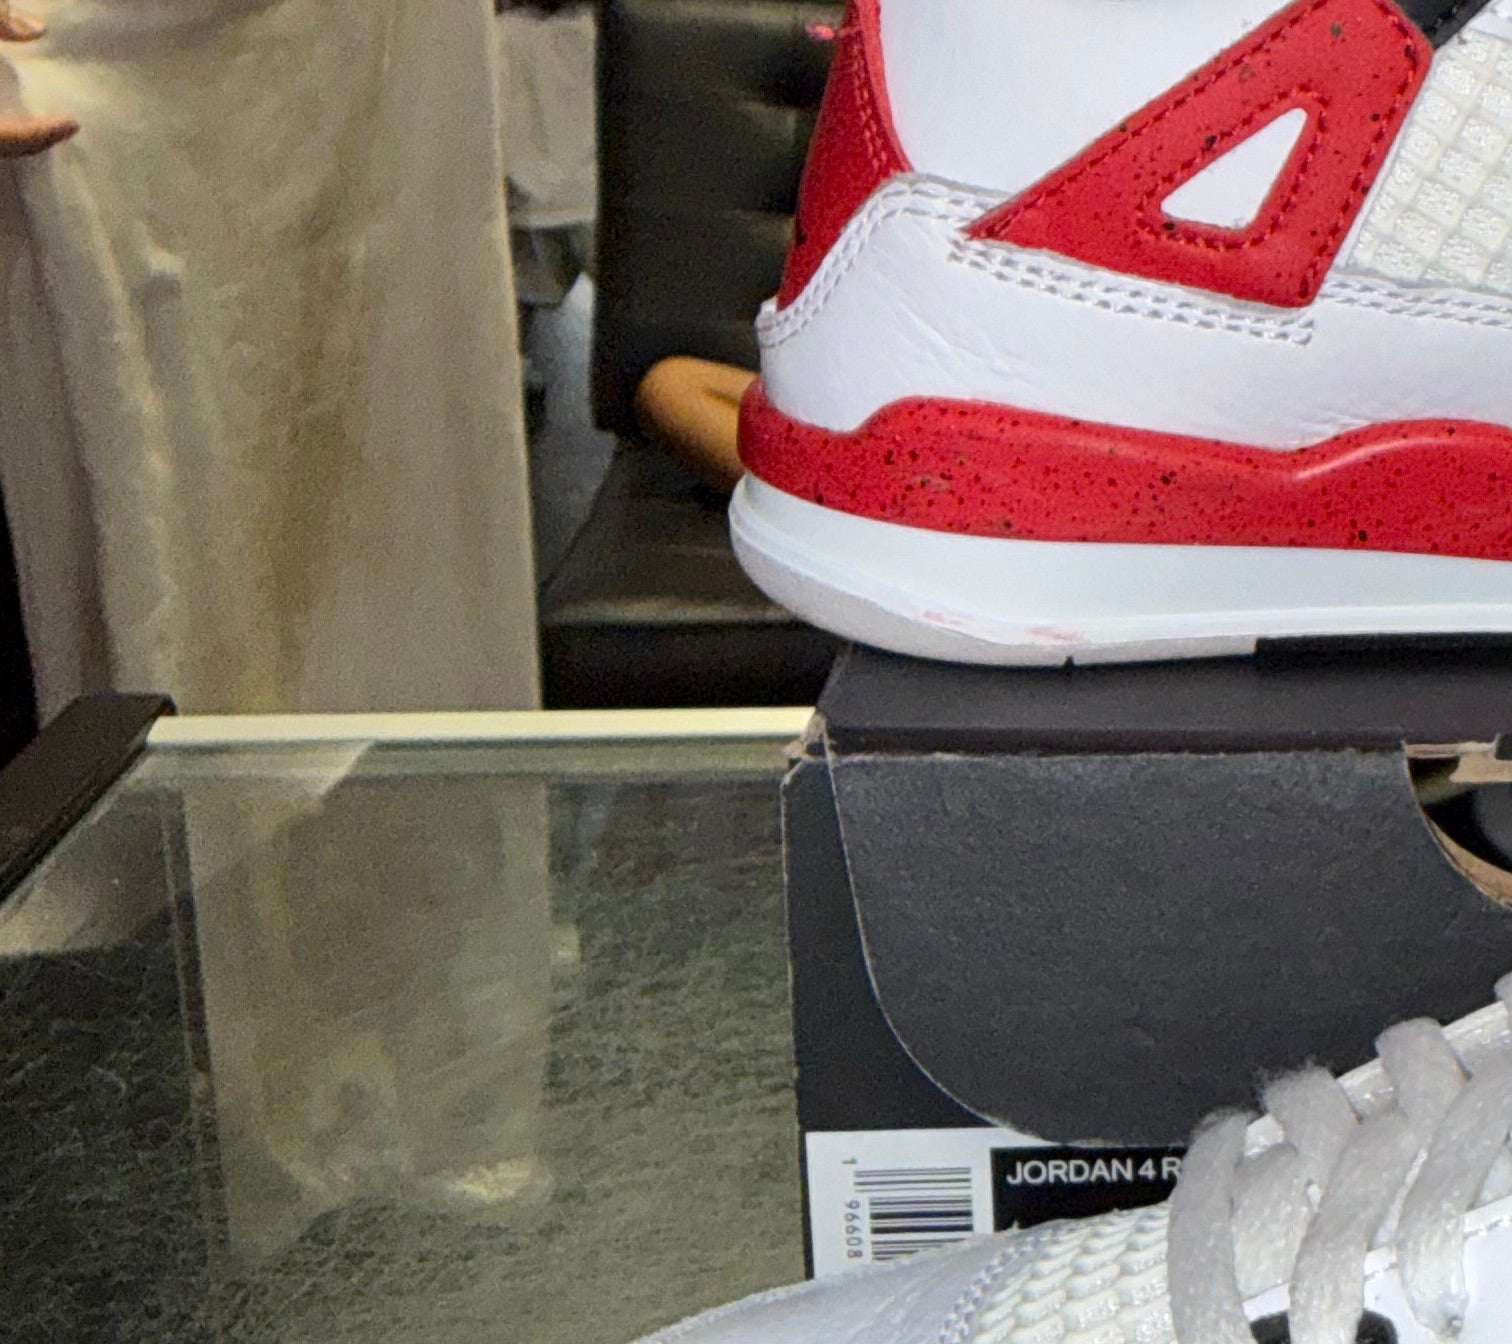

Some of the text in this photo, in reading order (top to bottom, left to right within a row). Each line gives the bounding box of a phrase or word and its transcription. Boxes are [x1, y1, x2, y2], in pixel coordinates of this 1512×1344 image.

[1006, 1157, 1133, 1186] JORDAN
[1138, 1158, 1157, 1181] 4
[844, 1199, 863, 1259] 96608
